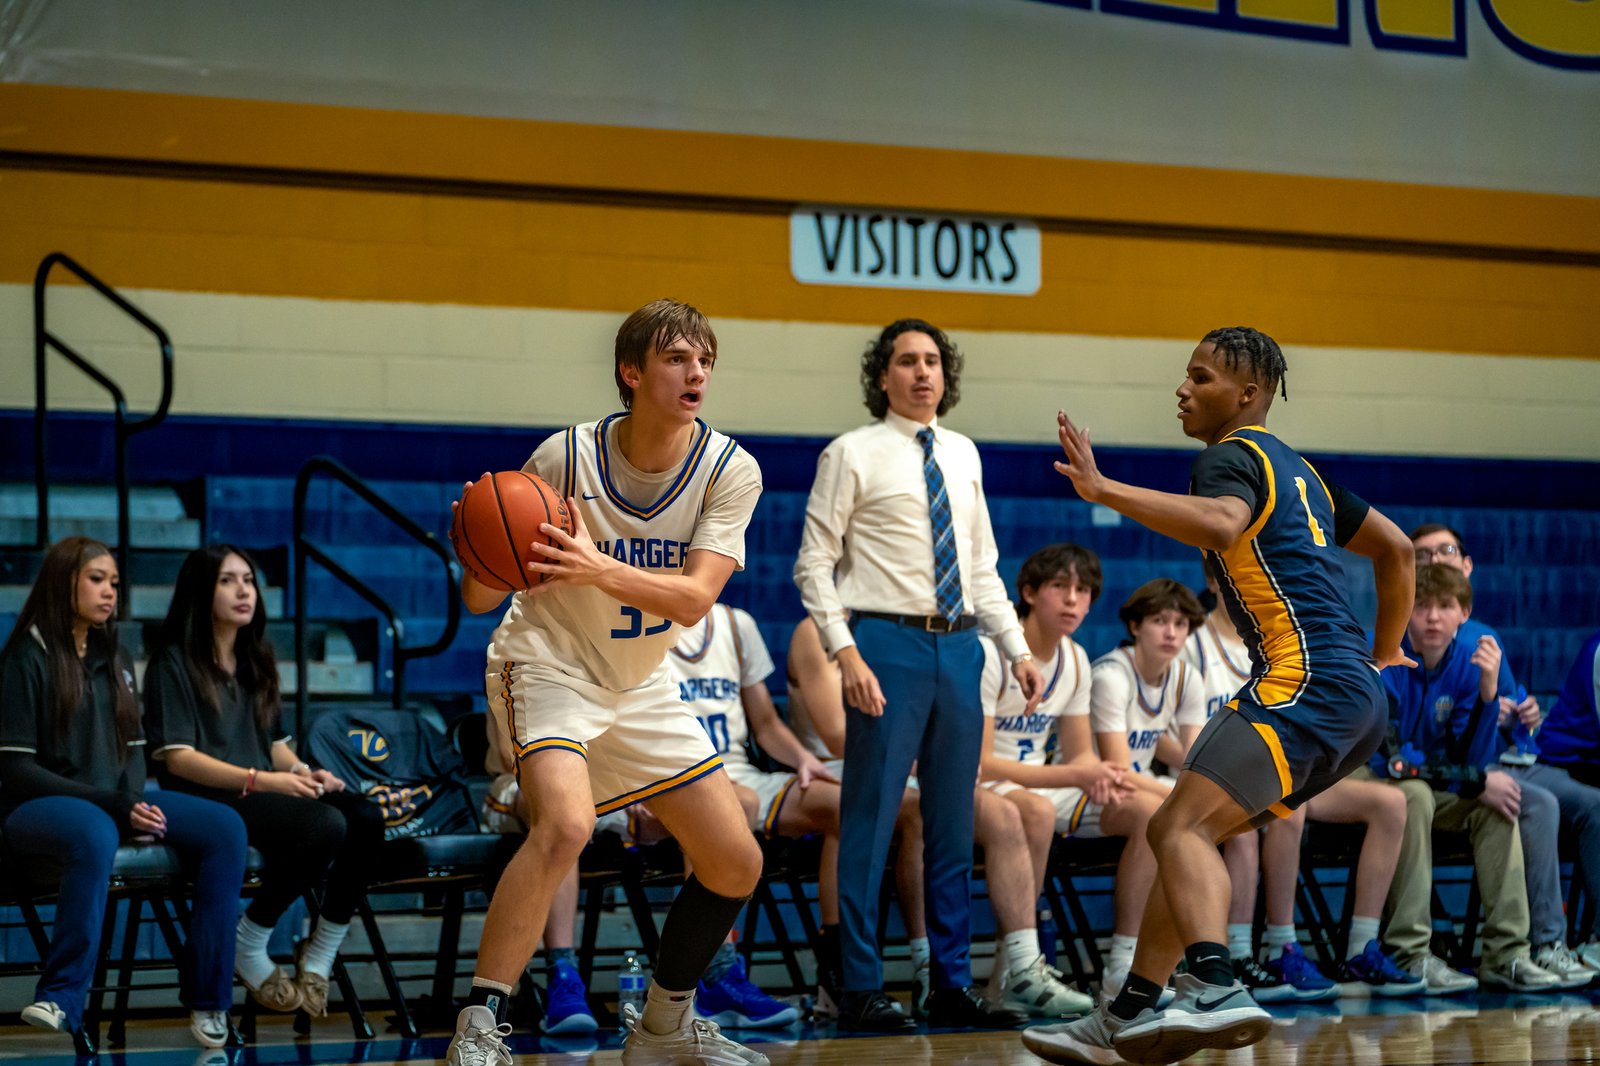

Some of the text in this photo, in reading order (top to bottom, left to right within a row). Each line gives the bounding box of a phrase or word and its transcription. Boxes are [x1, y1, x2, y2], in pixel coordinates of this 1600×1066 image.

[814, 212, 1018, 283] VISITORS
[1294, 476, 1327, 547] 1
[595, 537, 690, 569] HARGER
